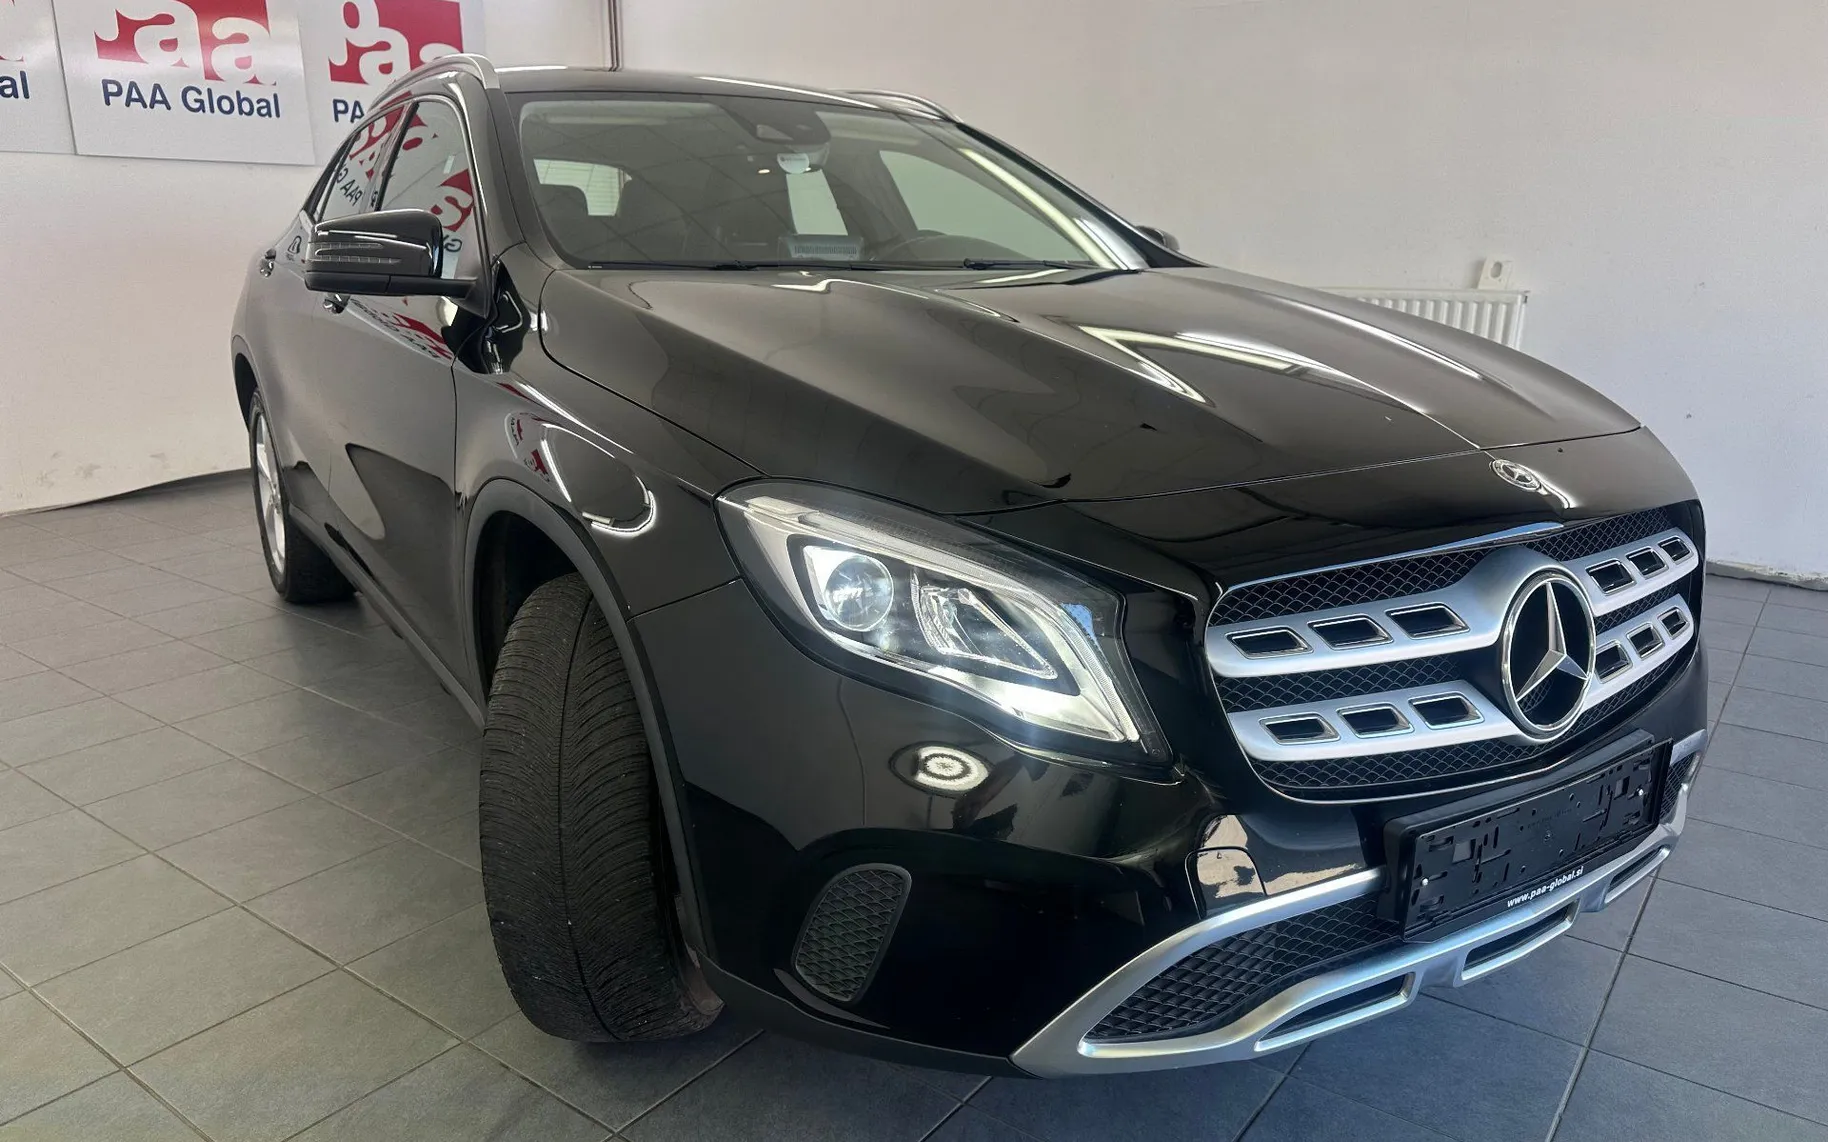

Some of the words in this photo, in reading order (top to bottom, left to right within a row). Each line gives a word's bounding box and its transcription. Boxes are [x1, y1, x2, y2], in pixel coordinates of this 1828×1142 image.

[101, 78, 171, 111] PAA
[181, 85, 281, 118] Global
[332, 98, 365, 123] PA
[1507, 865, 1584, 908] www.paa-global.si
